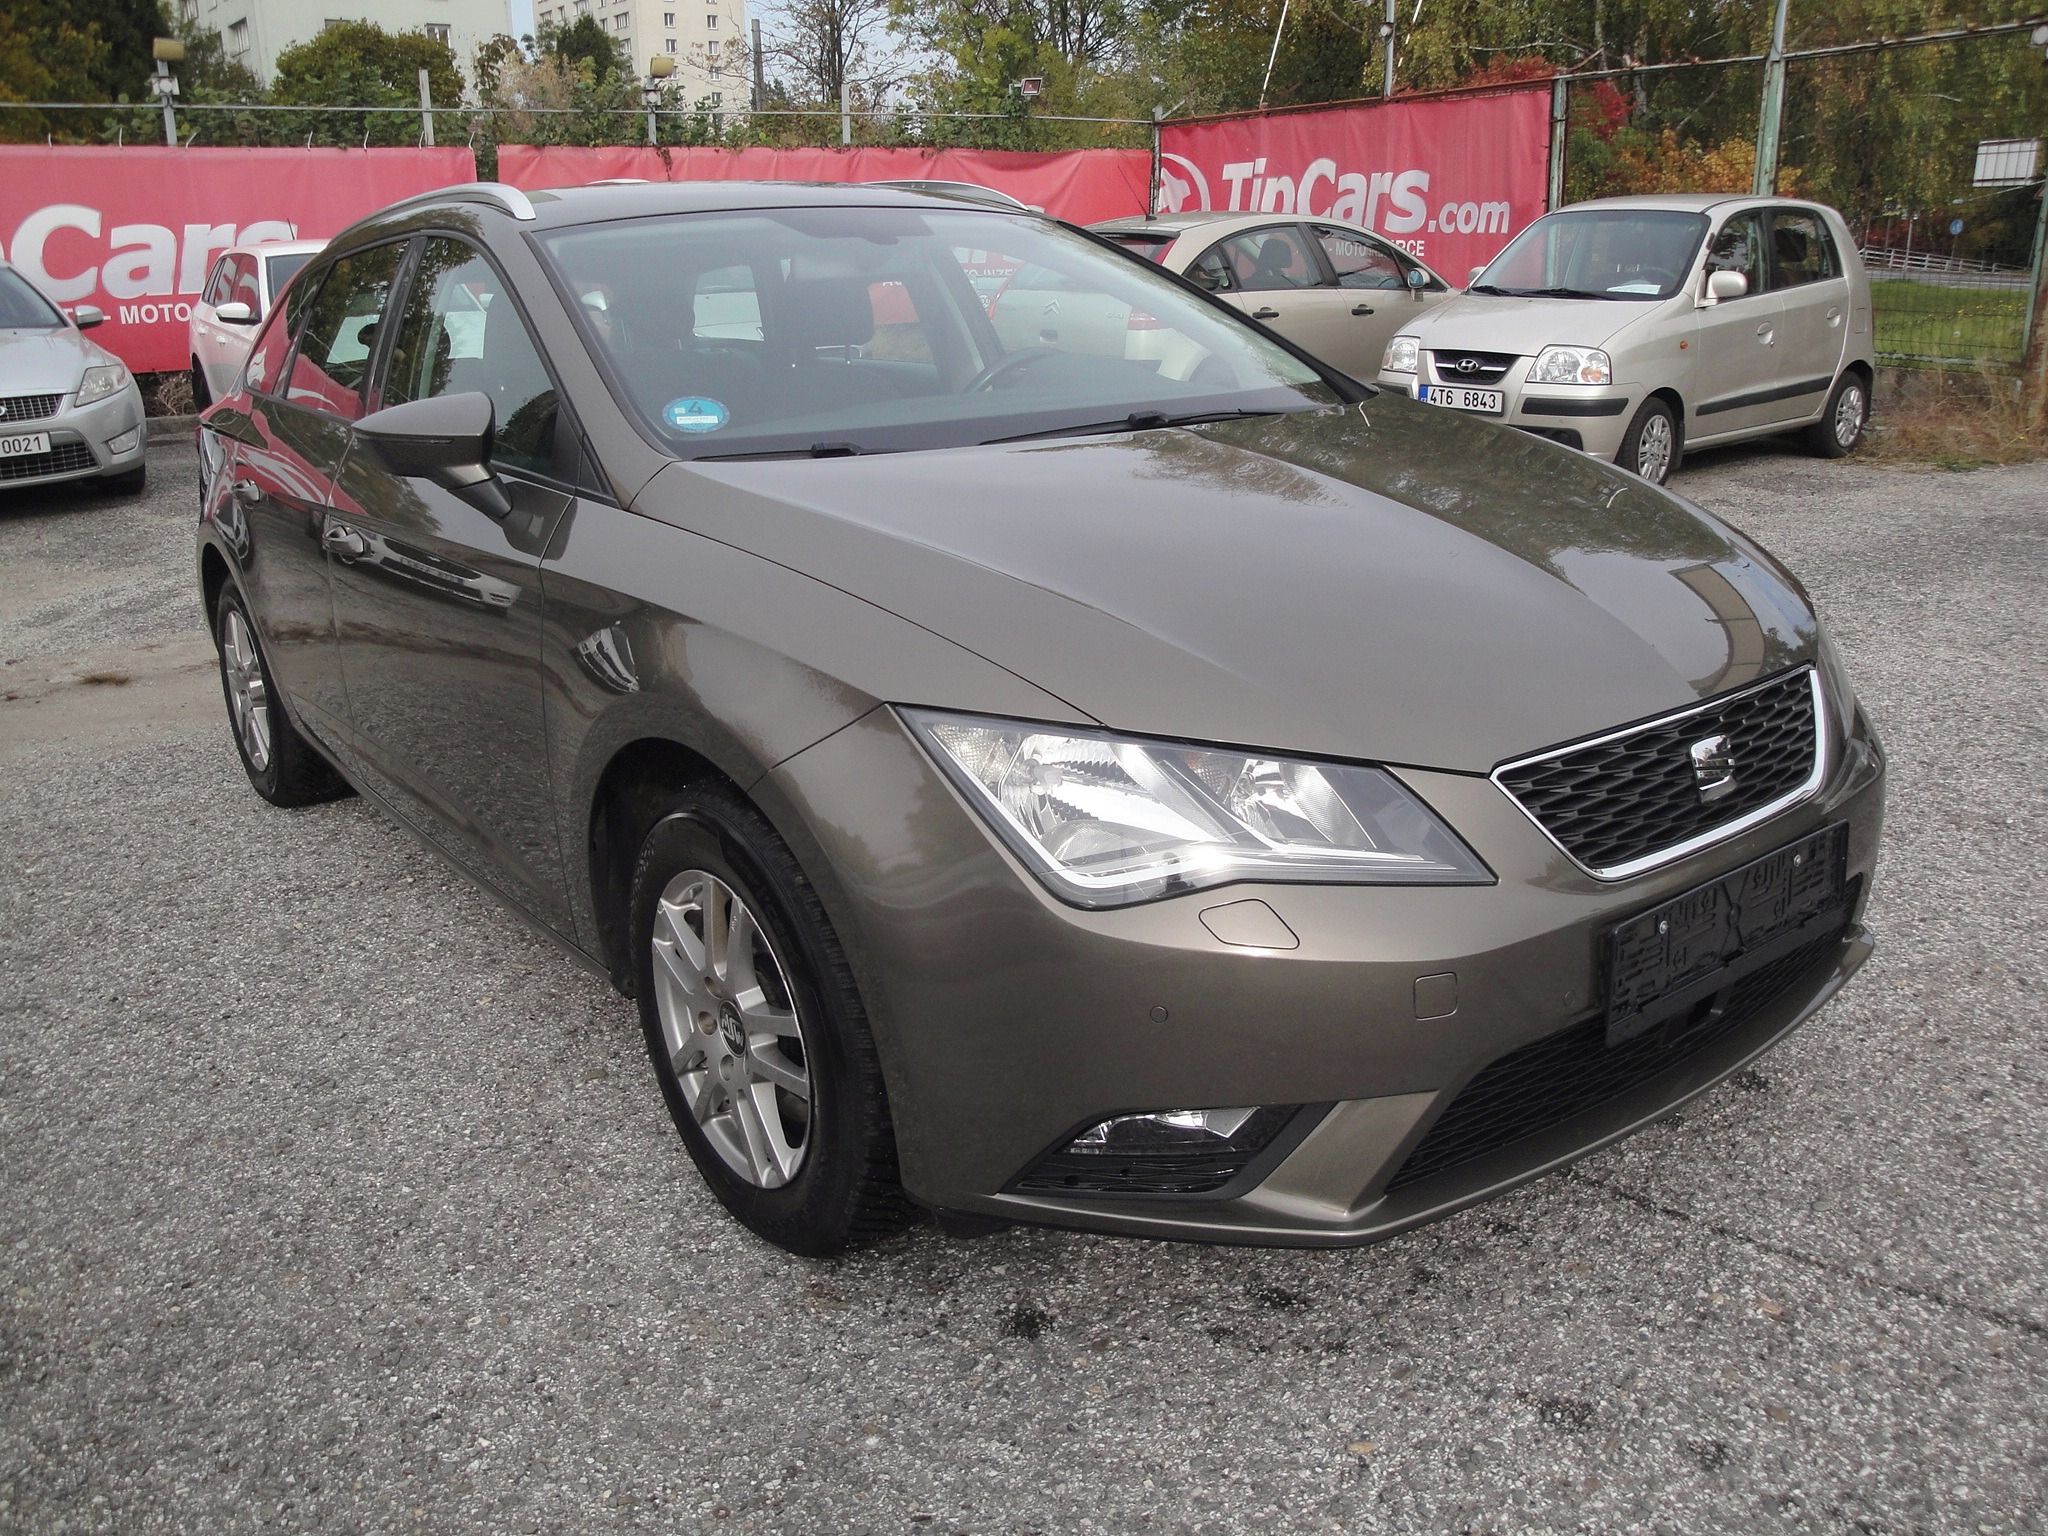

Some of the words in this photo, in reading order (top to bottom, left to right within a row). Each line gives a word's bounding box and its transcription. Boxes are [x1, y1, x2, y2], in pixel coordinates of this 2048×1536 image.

[0, 203, 298, 300] Car
[119, 302, 192, 325] MOTO
[1430, 388, 1454, 405] 4T6
[1464, 391, 1496, 409] 6843
[1, 435, 42, 454] 0021
